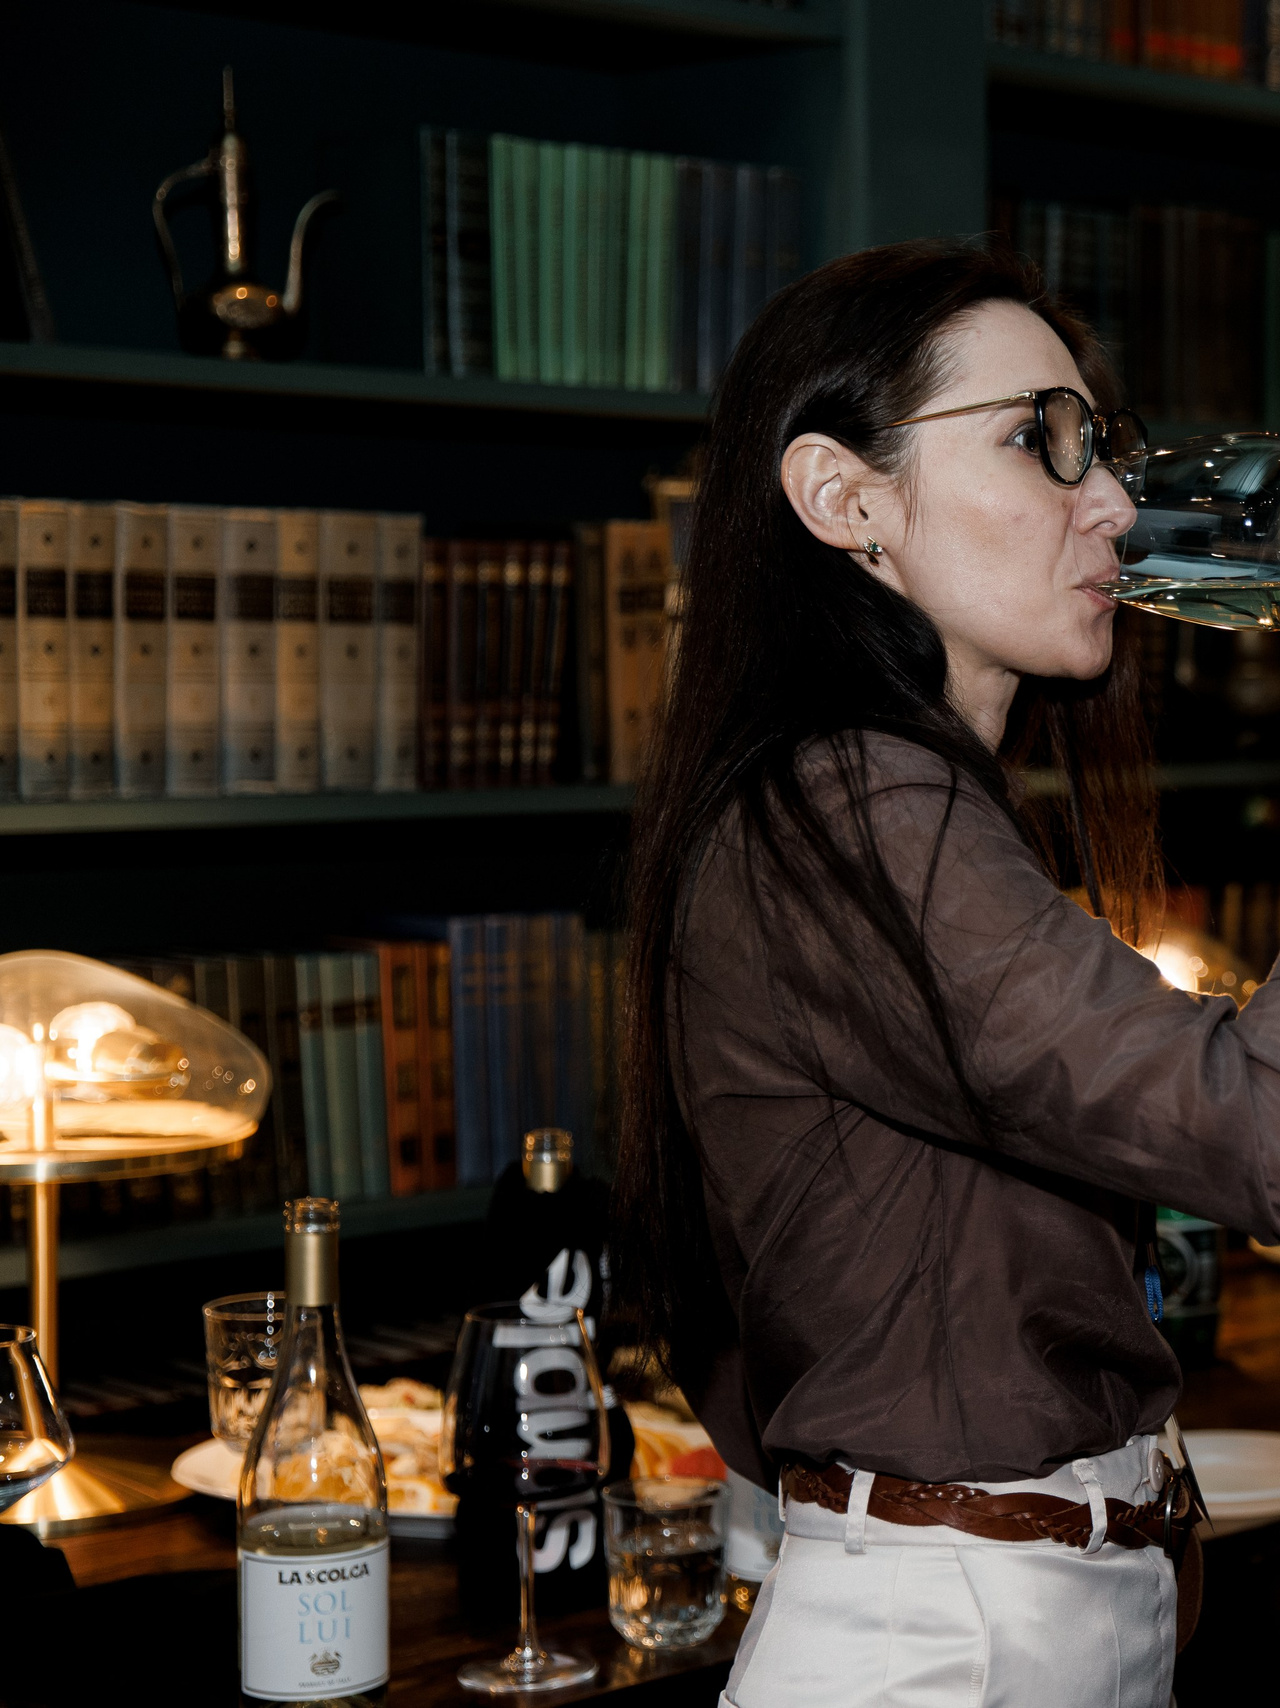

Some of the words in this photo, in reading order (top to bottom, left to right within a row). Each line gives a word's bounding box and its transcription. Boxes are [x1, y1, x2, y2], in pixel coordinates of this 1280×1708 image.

[491, 1247, 619, 1574] simple
[278, 1571, 302, 1584] LA
[305, 1562, 370, 1585] SCOLCA
[298, 1588, 352, 1617] SOL
[298, 1617, 351, 1644] LUI
